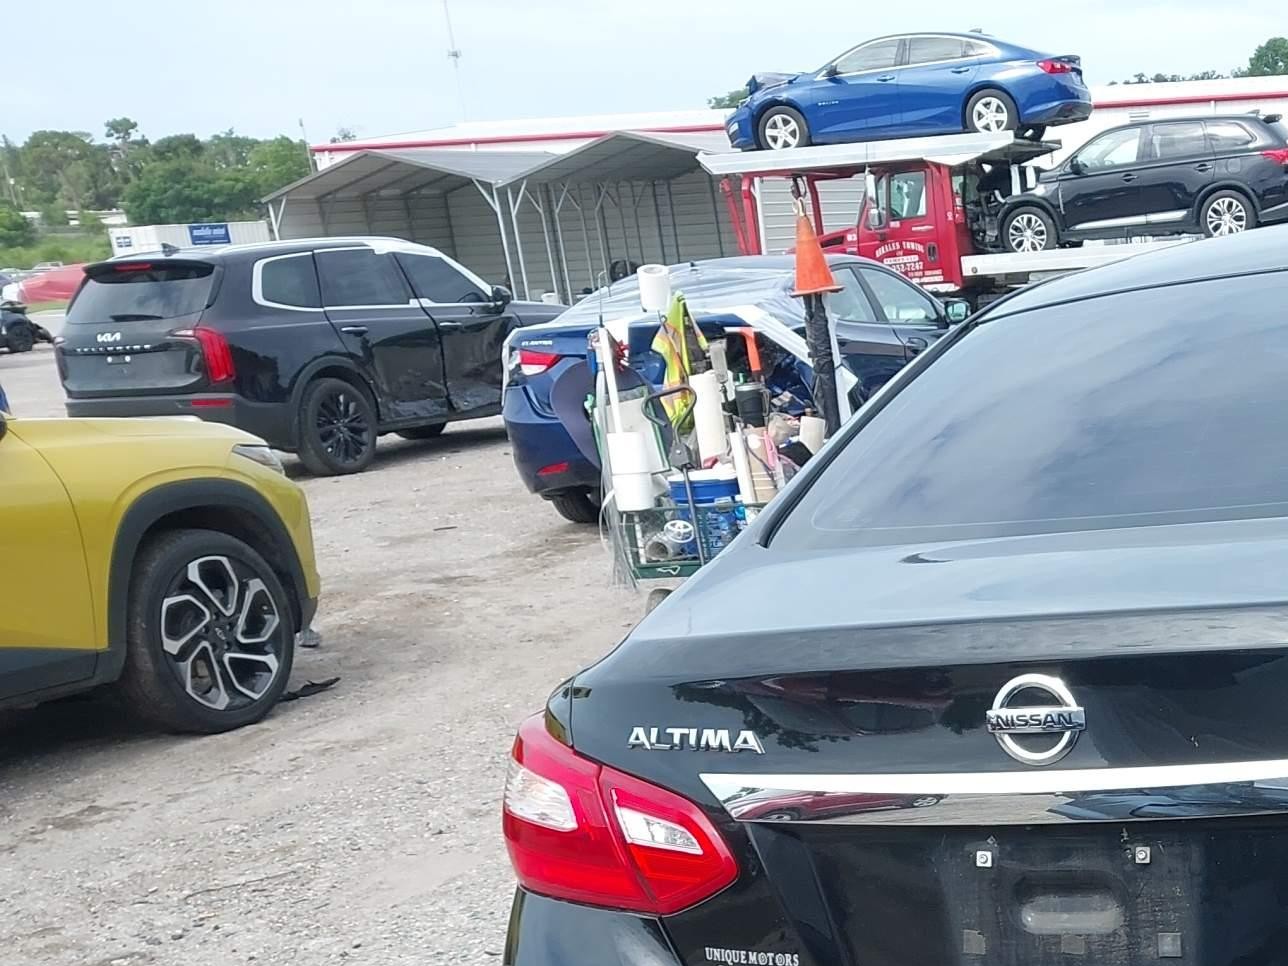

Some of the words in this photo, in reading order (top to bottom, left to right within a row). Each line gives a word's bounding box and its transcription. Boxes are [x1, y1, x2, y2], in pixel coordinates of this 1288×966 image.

[96, 332, 121, 342] KIA
[994, 712, 1073, 730] NISSAN
[627, 726, 766, 754] ALTIMA
[704, 947, 747, 966] UNIQUE
[748, 951, 800, 966] MOTORS
